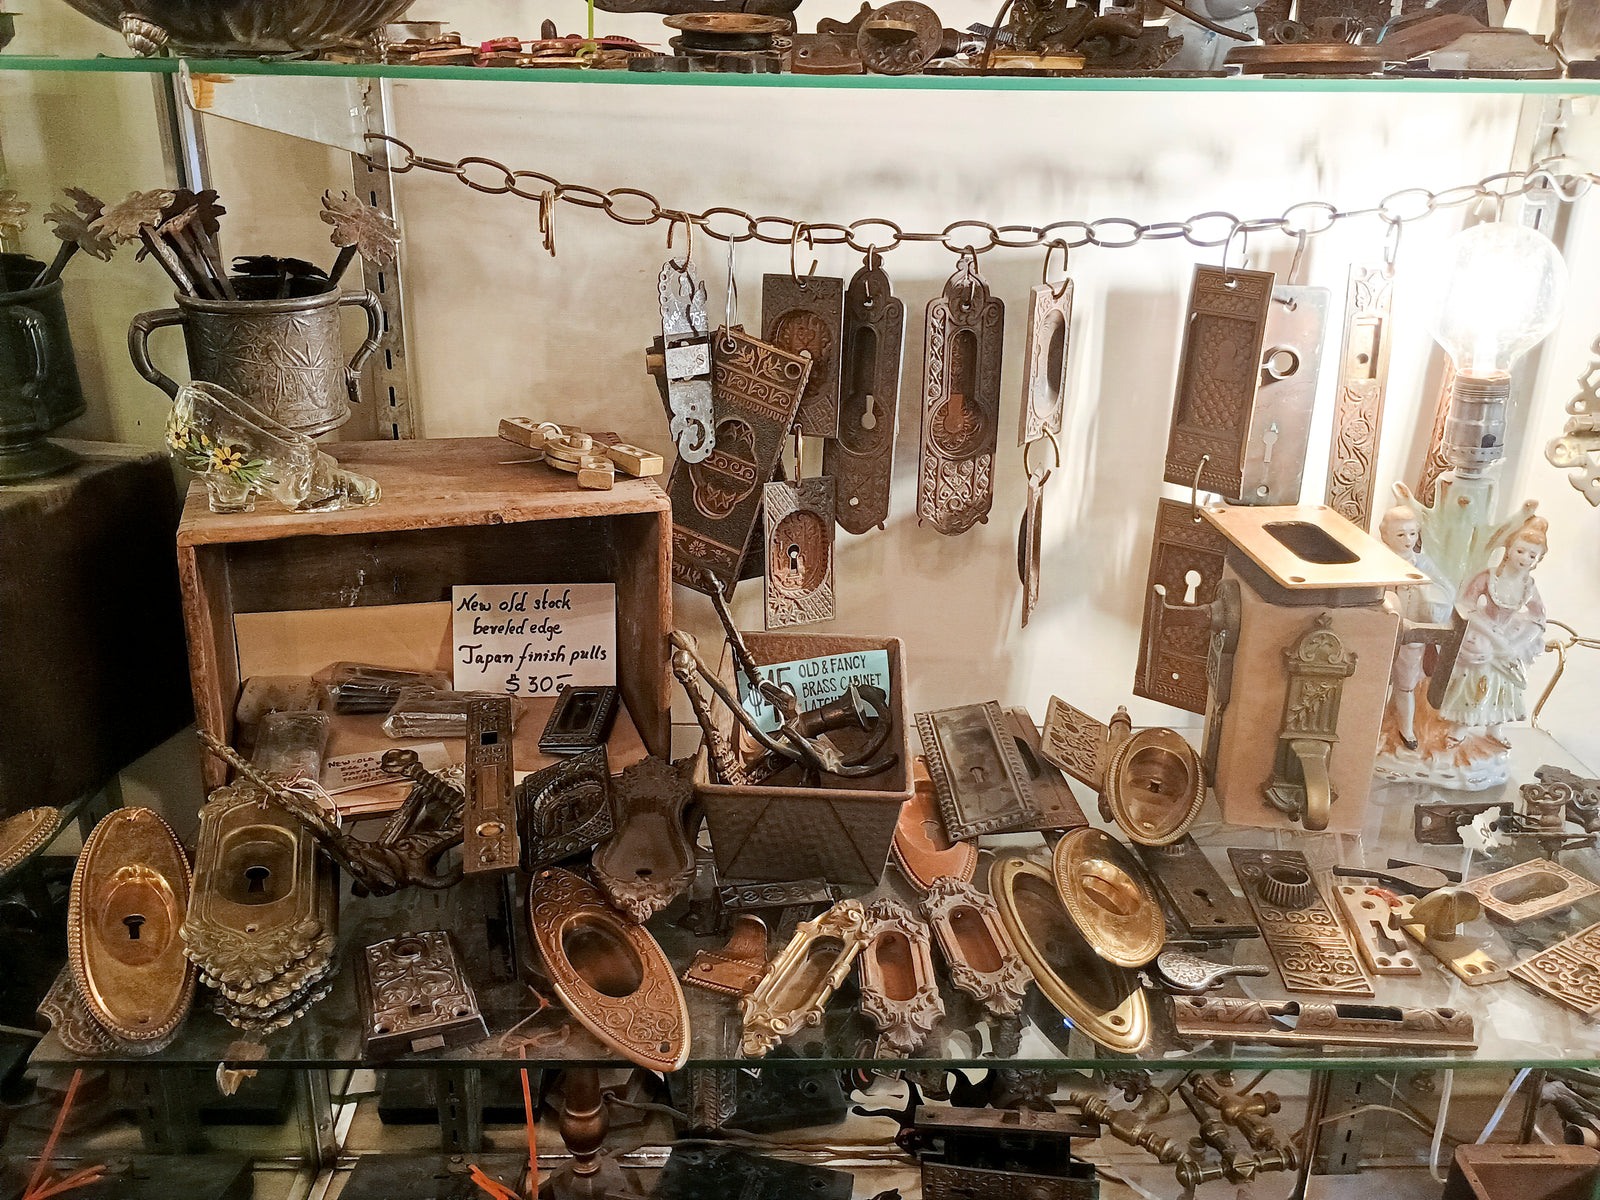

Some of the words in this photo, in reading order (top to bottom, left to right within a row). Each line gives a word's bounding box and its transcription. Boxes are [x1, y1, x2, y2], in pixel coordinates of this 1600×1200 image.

[457, 593, 491, 611] New
[499, 592, 528, 612] old
[533, 589, 571, 610] stock
[473, 617, 528, 635] beveled
[530, 617, 562, 641] edge
[458, 644, 514, 673] Japan
[515, 643, 565, 671] finish
[569, 645, 607, 666] pulls
[798, 661, 820, 679] OLD
[821, 660, 829, 675] &
[831, 655, 867, 673] FANCY
[802, 678, 837, 698] BRASS
[840, 673, 882, 690] CABINET
